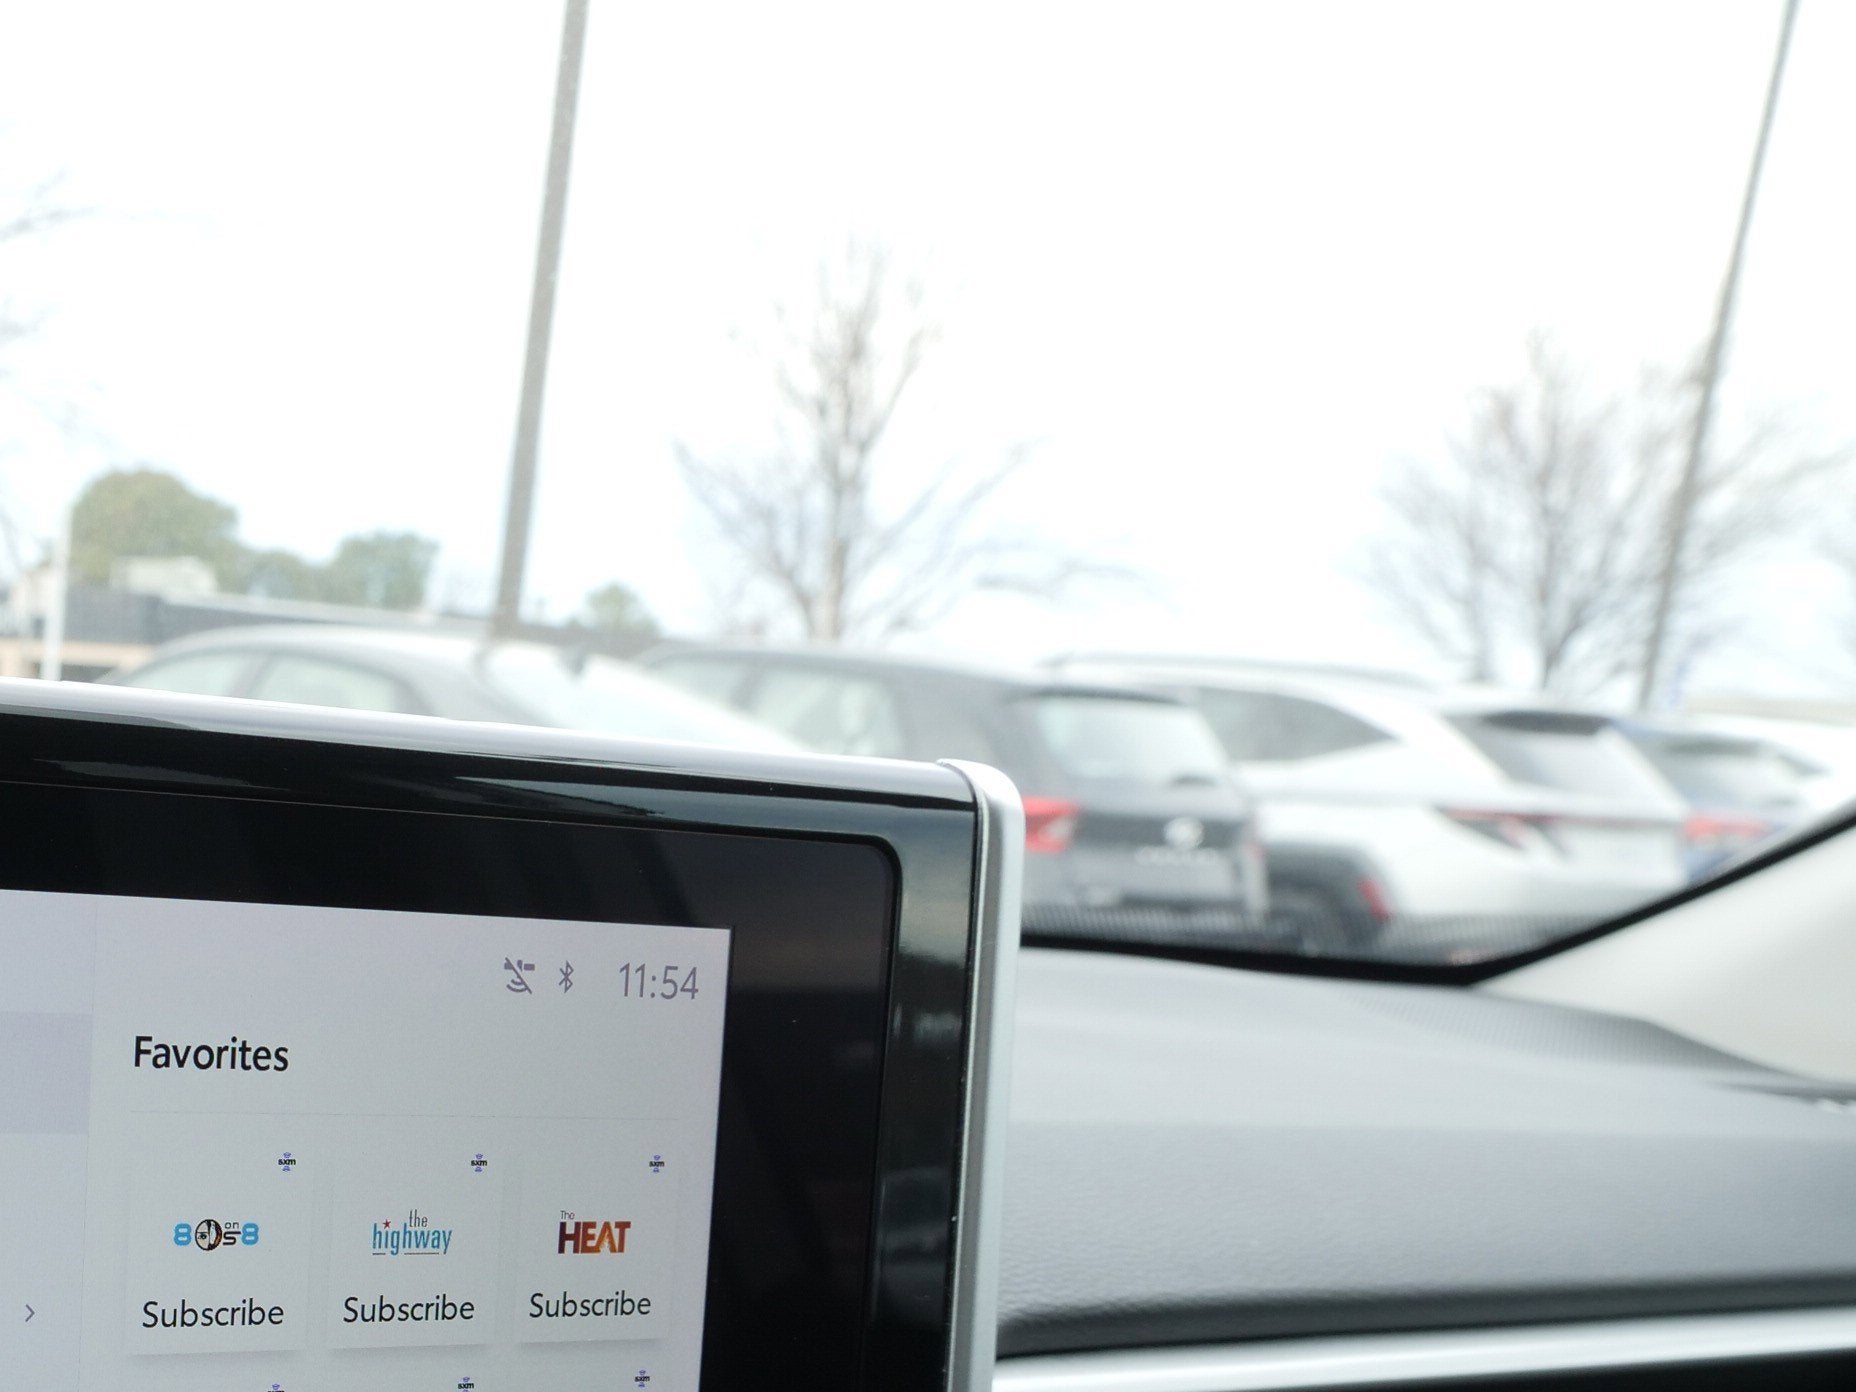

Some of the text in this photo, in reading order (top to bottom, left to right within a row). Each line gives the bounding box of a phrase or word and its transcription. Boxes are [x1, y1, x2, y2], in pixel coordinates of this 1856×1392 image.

[619, 962, 699, 1000] 11:54
[134, 1035, 289, 1072] Favorites
[409, 1209, 428, 1228] the
[560, 1210, 576, 1220] The
[372, 1222, 453, 1256] highway
[557, 1221, 632, 1254] HEAT
[142, 1297, 284, 1329] Subscribe
[343, 1293, 475, 1323] Subscribe
[529, 1289, 652, 1319] Subscribe
